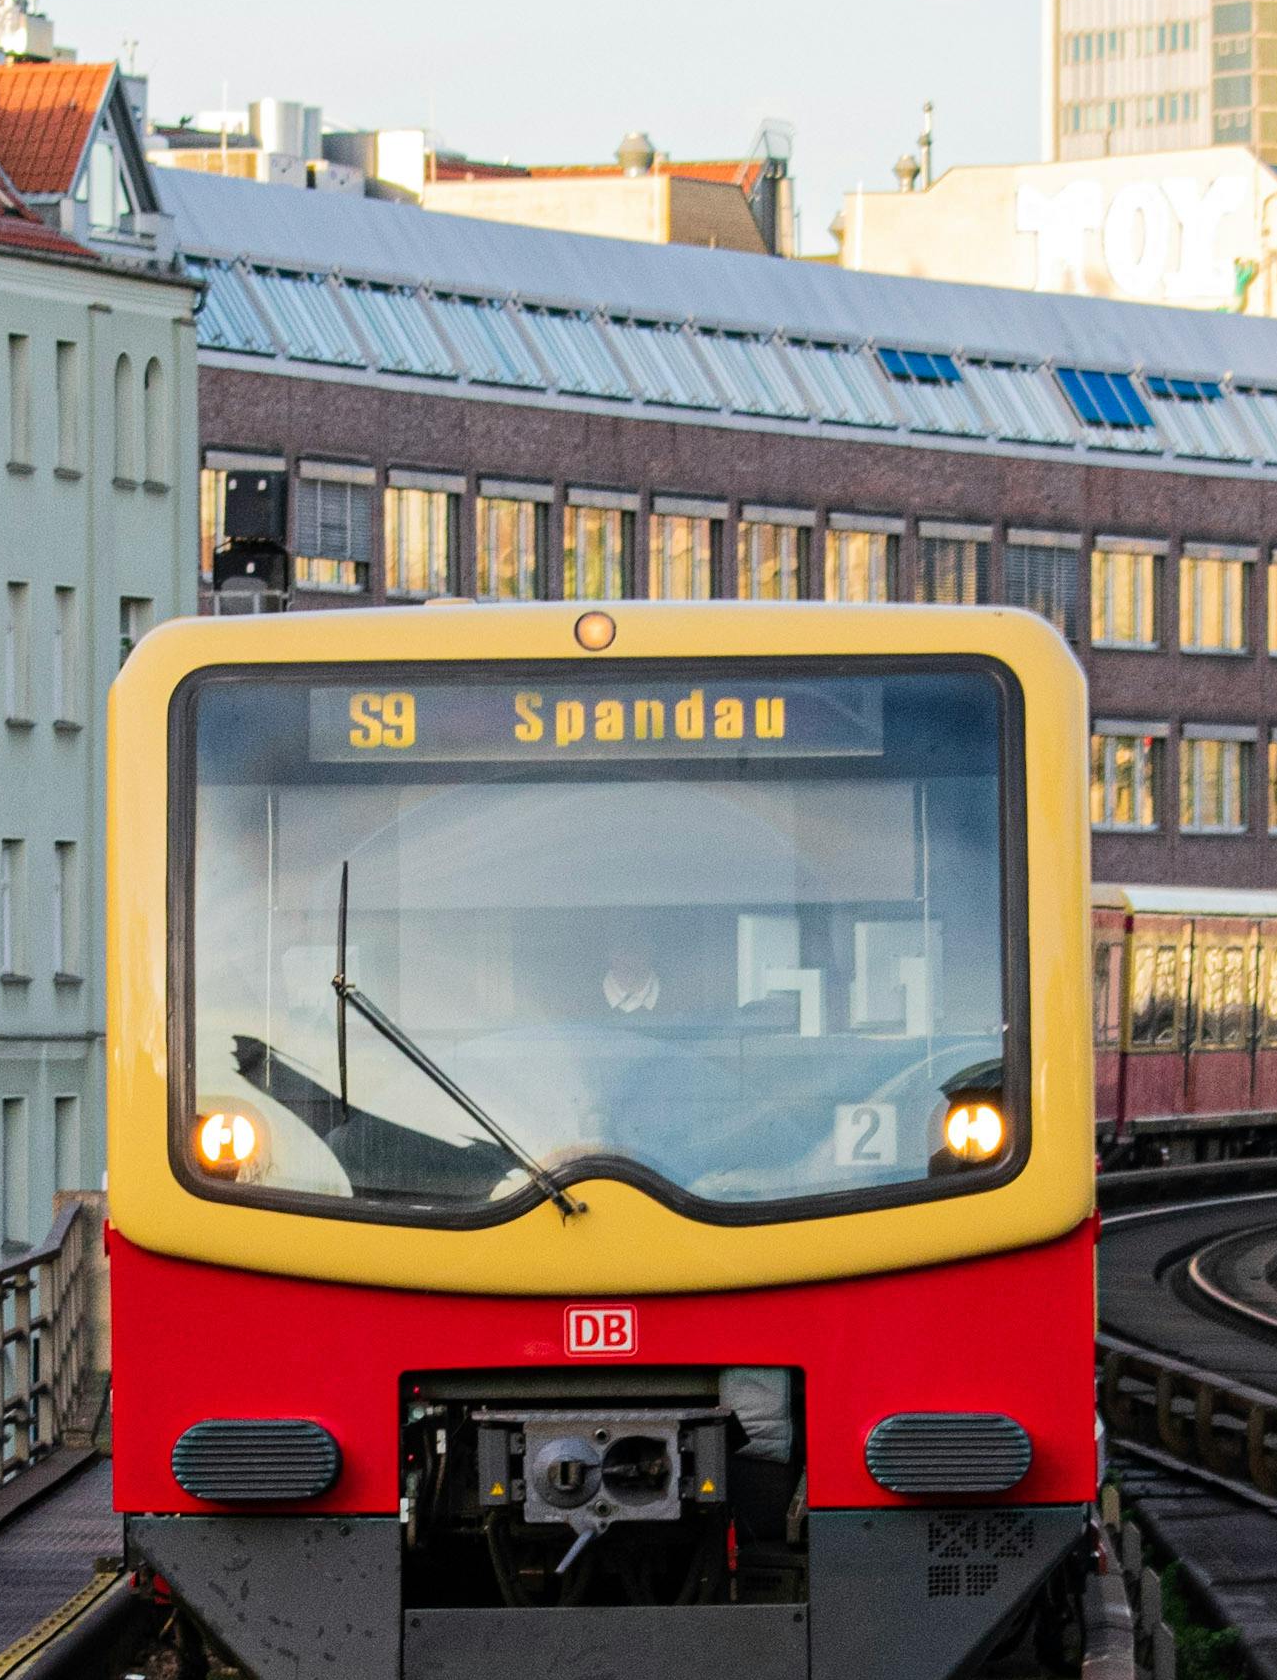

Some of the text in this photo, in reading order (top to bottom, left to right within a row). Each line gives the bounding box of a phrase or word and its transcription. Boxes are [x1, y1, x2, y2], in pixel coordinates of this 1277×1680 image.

[349, 689, 785, 749] S9 Spandau
[852, 1107, 881, 1161] 2
[575, 1314, 628, 1347] DB
